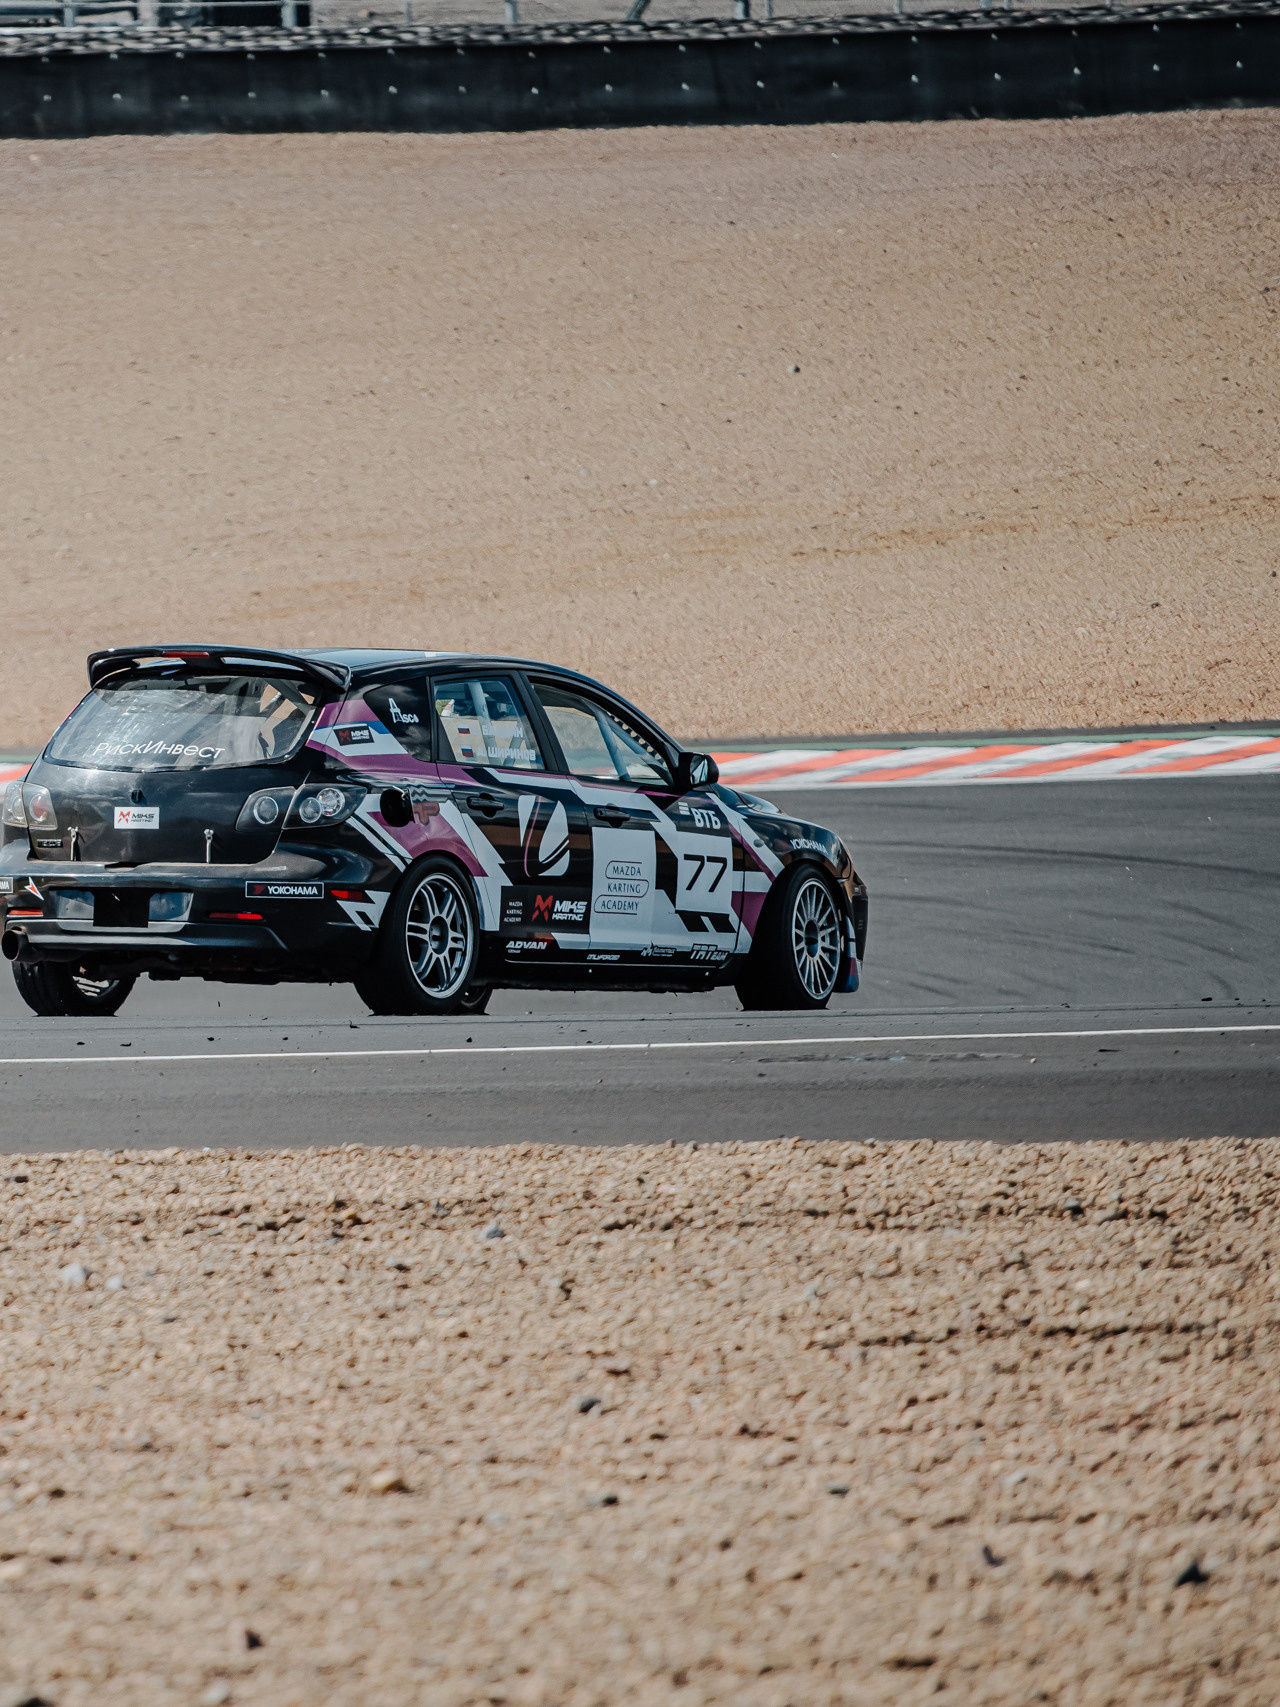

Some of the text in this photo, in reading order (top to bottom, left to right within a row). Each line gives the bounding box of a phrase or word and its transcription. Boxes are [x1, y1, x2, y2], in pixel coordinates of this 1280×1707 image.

[690, 808, 721, 830] ВТБ
[790, 838, 829, 855] YOKOHAMA
[612, 865, 641, 877] MAZDA
[684, 854, 728, 893] 77
[267, 886, 319, 895] YOKOHAMA
[607, 882, 641, 894] KARTING
[554, 900, 588, 914] MIKS
[601, 900, 640, 911] ACADEMY
[552, 913, 585, 921] KARTING
[506, 941, 548, 950] ADVAN
